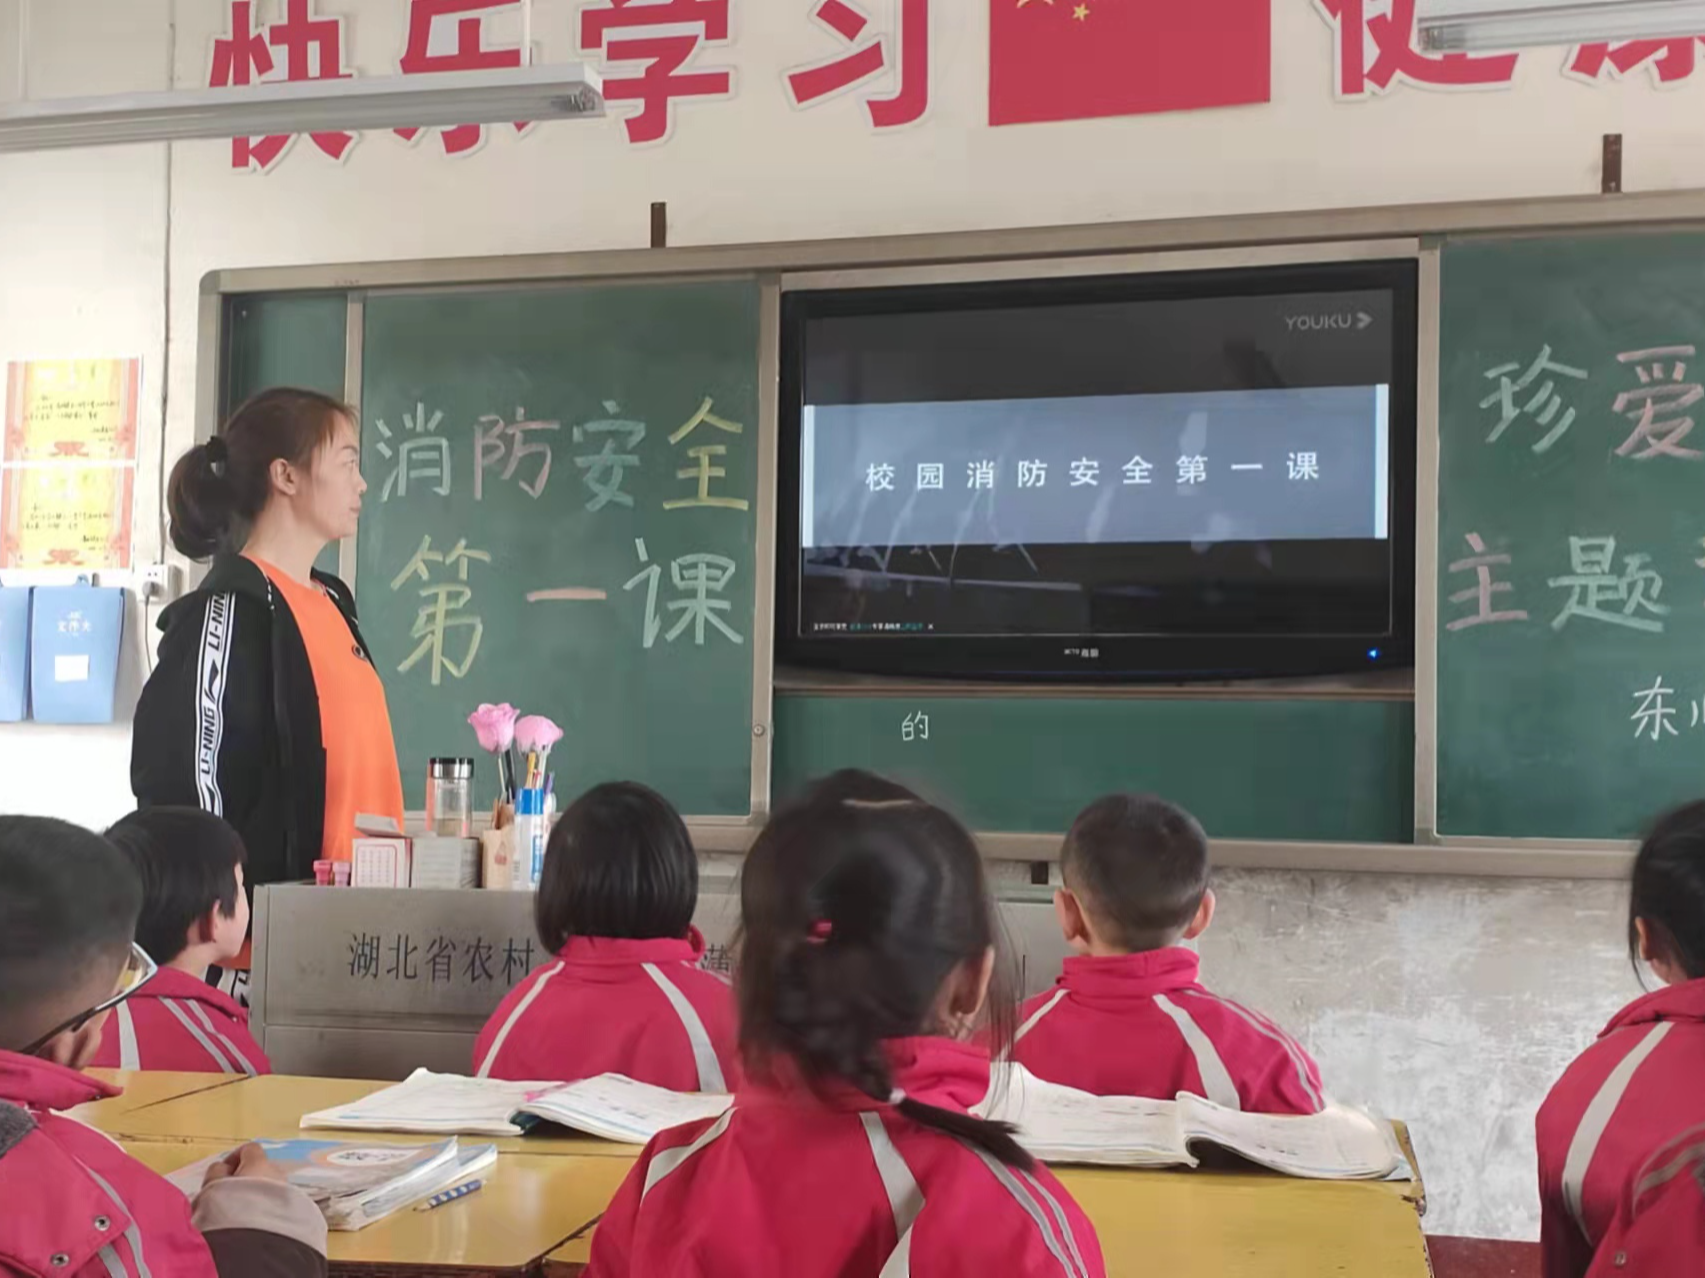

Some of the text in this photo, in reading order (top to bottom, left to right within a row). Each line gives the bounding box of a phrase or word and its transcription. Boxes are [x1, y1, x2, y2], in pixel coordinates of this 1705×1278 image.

[1284, 313, 1352, 330] YOUKU
[1479, 344, 1705, 460] 珍爱
[375, 396, 749, 512] 消防安全
[865, 451, 1320, 492] 校园消防安全第一课
[390, 534, 744, 685] 第一课
[1446, 532, 1705, 633] 主题
[208, 591, 226, 651] LI-NIN
[902, 710, 928, 741] 的
[1631, 676, 1705, 740] 东
[201, 706, 215, 775] LI-NING
[347, 932, 535, 986] 湖北省农村
